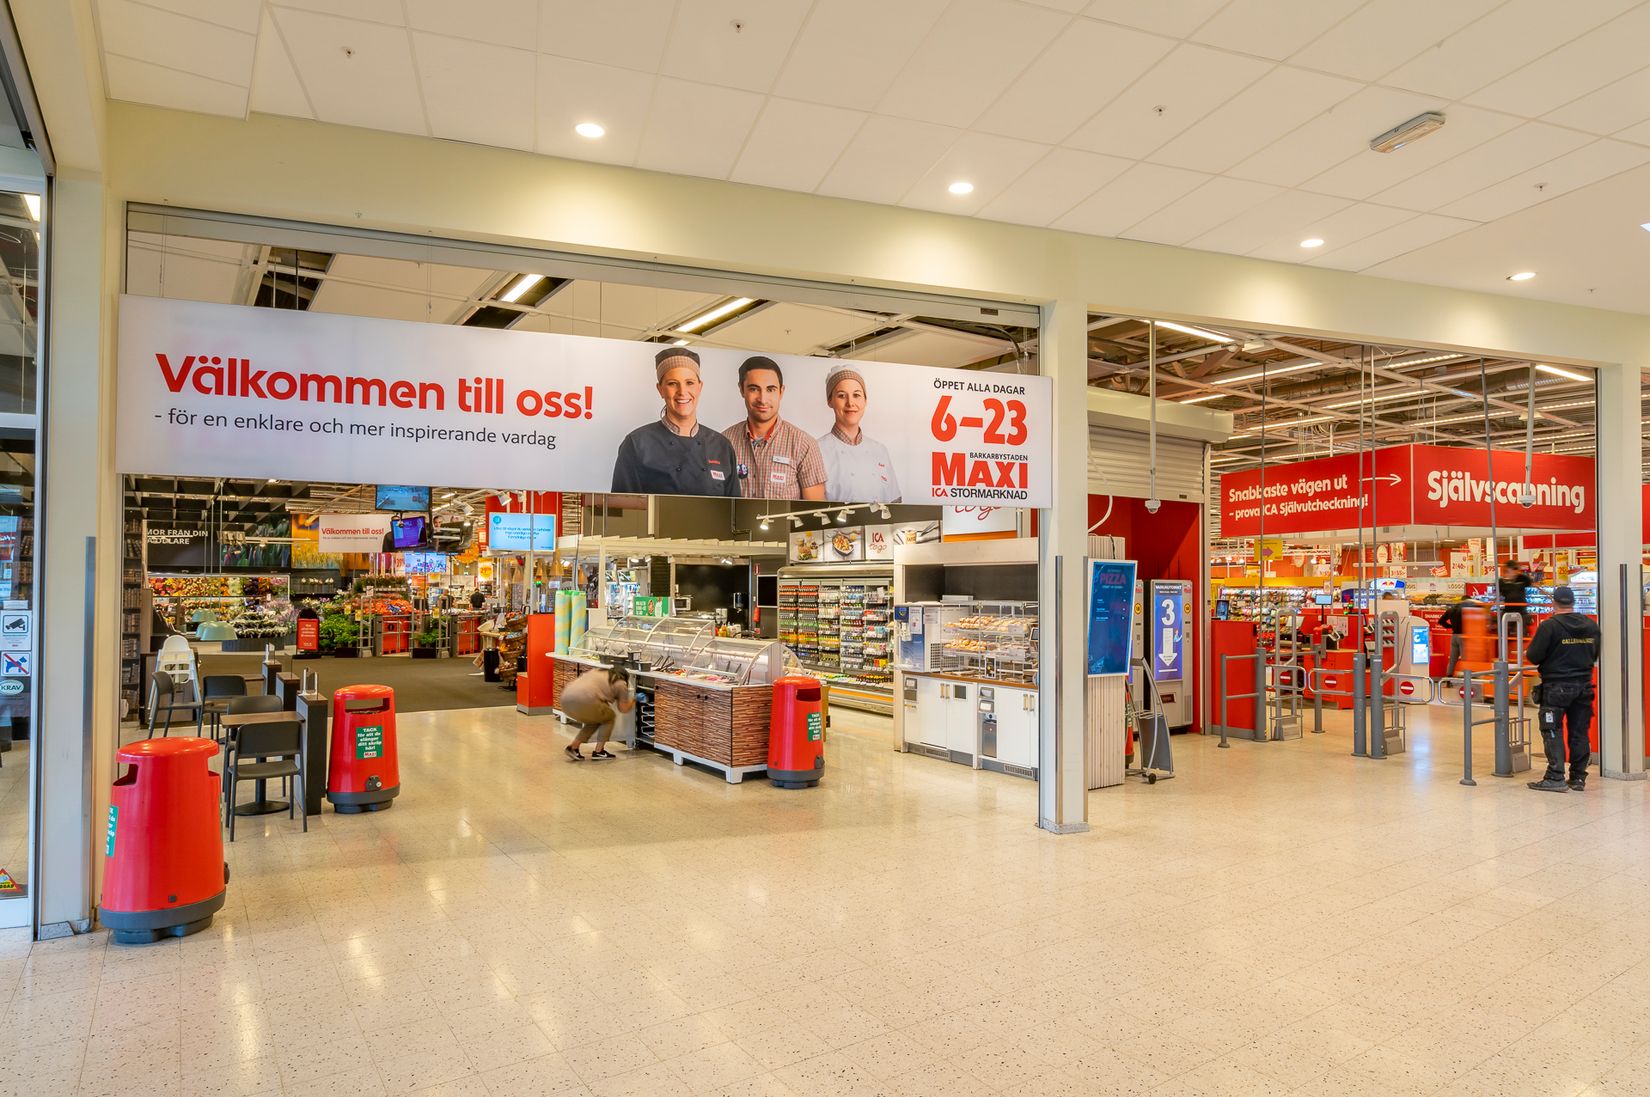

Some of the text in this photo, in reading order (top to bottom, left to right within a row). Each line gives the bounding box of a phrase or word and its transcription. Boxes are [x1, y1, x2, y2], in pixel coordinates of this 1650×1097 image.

[155, 353, 593, 420] Välkommen till oss!
[933, 377, 1025, 395] ÖPPET ALLA DAGAR
[168, 408, 198, 425] för
[203, 413, 228, 427] en
[234, 413, 304, 432] enklare
[309, 417, 344, 434] och
[350, 422, 386, 436] mer
[390, 422, 497, 443] inspirerande
[501, 430, 556, 450] vardag
[969, 452, 1029, 461] BARKARBYSTADEN
[931, 451, 1029, 489] MAXI
[931, 487, 1029, 500] ICA STORMARKNAD
[1290, 478, 1331, 497] vägen
[1334, 474, 1348, 490] ut
[1235, 508, 1261, 521] prova
[1280, 493, 1369, 516] Självutcheckning!
[321, 527, 385, 535] Välkommen till oss!
[872, 532, 884, 543] ICA
[1099, 573, 1127, 585] PIZZA
[1161, 599, 1176, 626] 3
